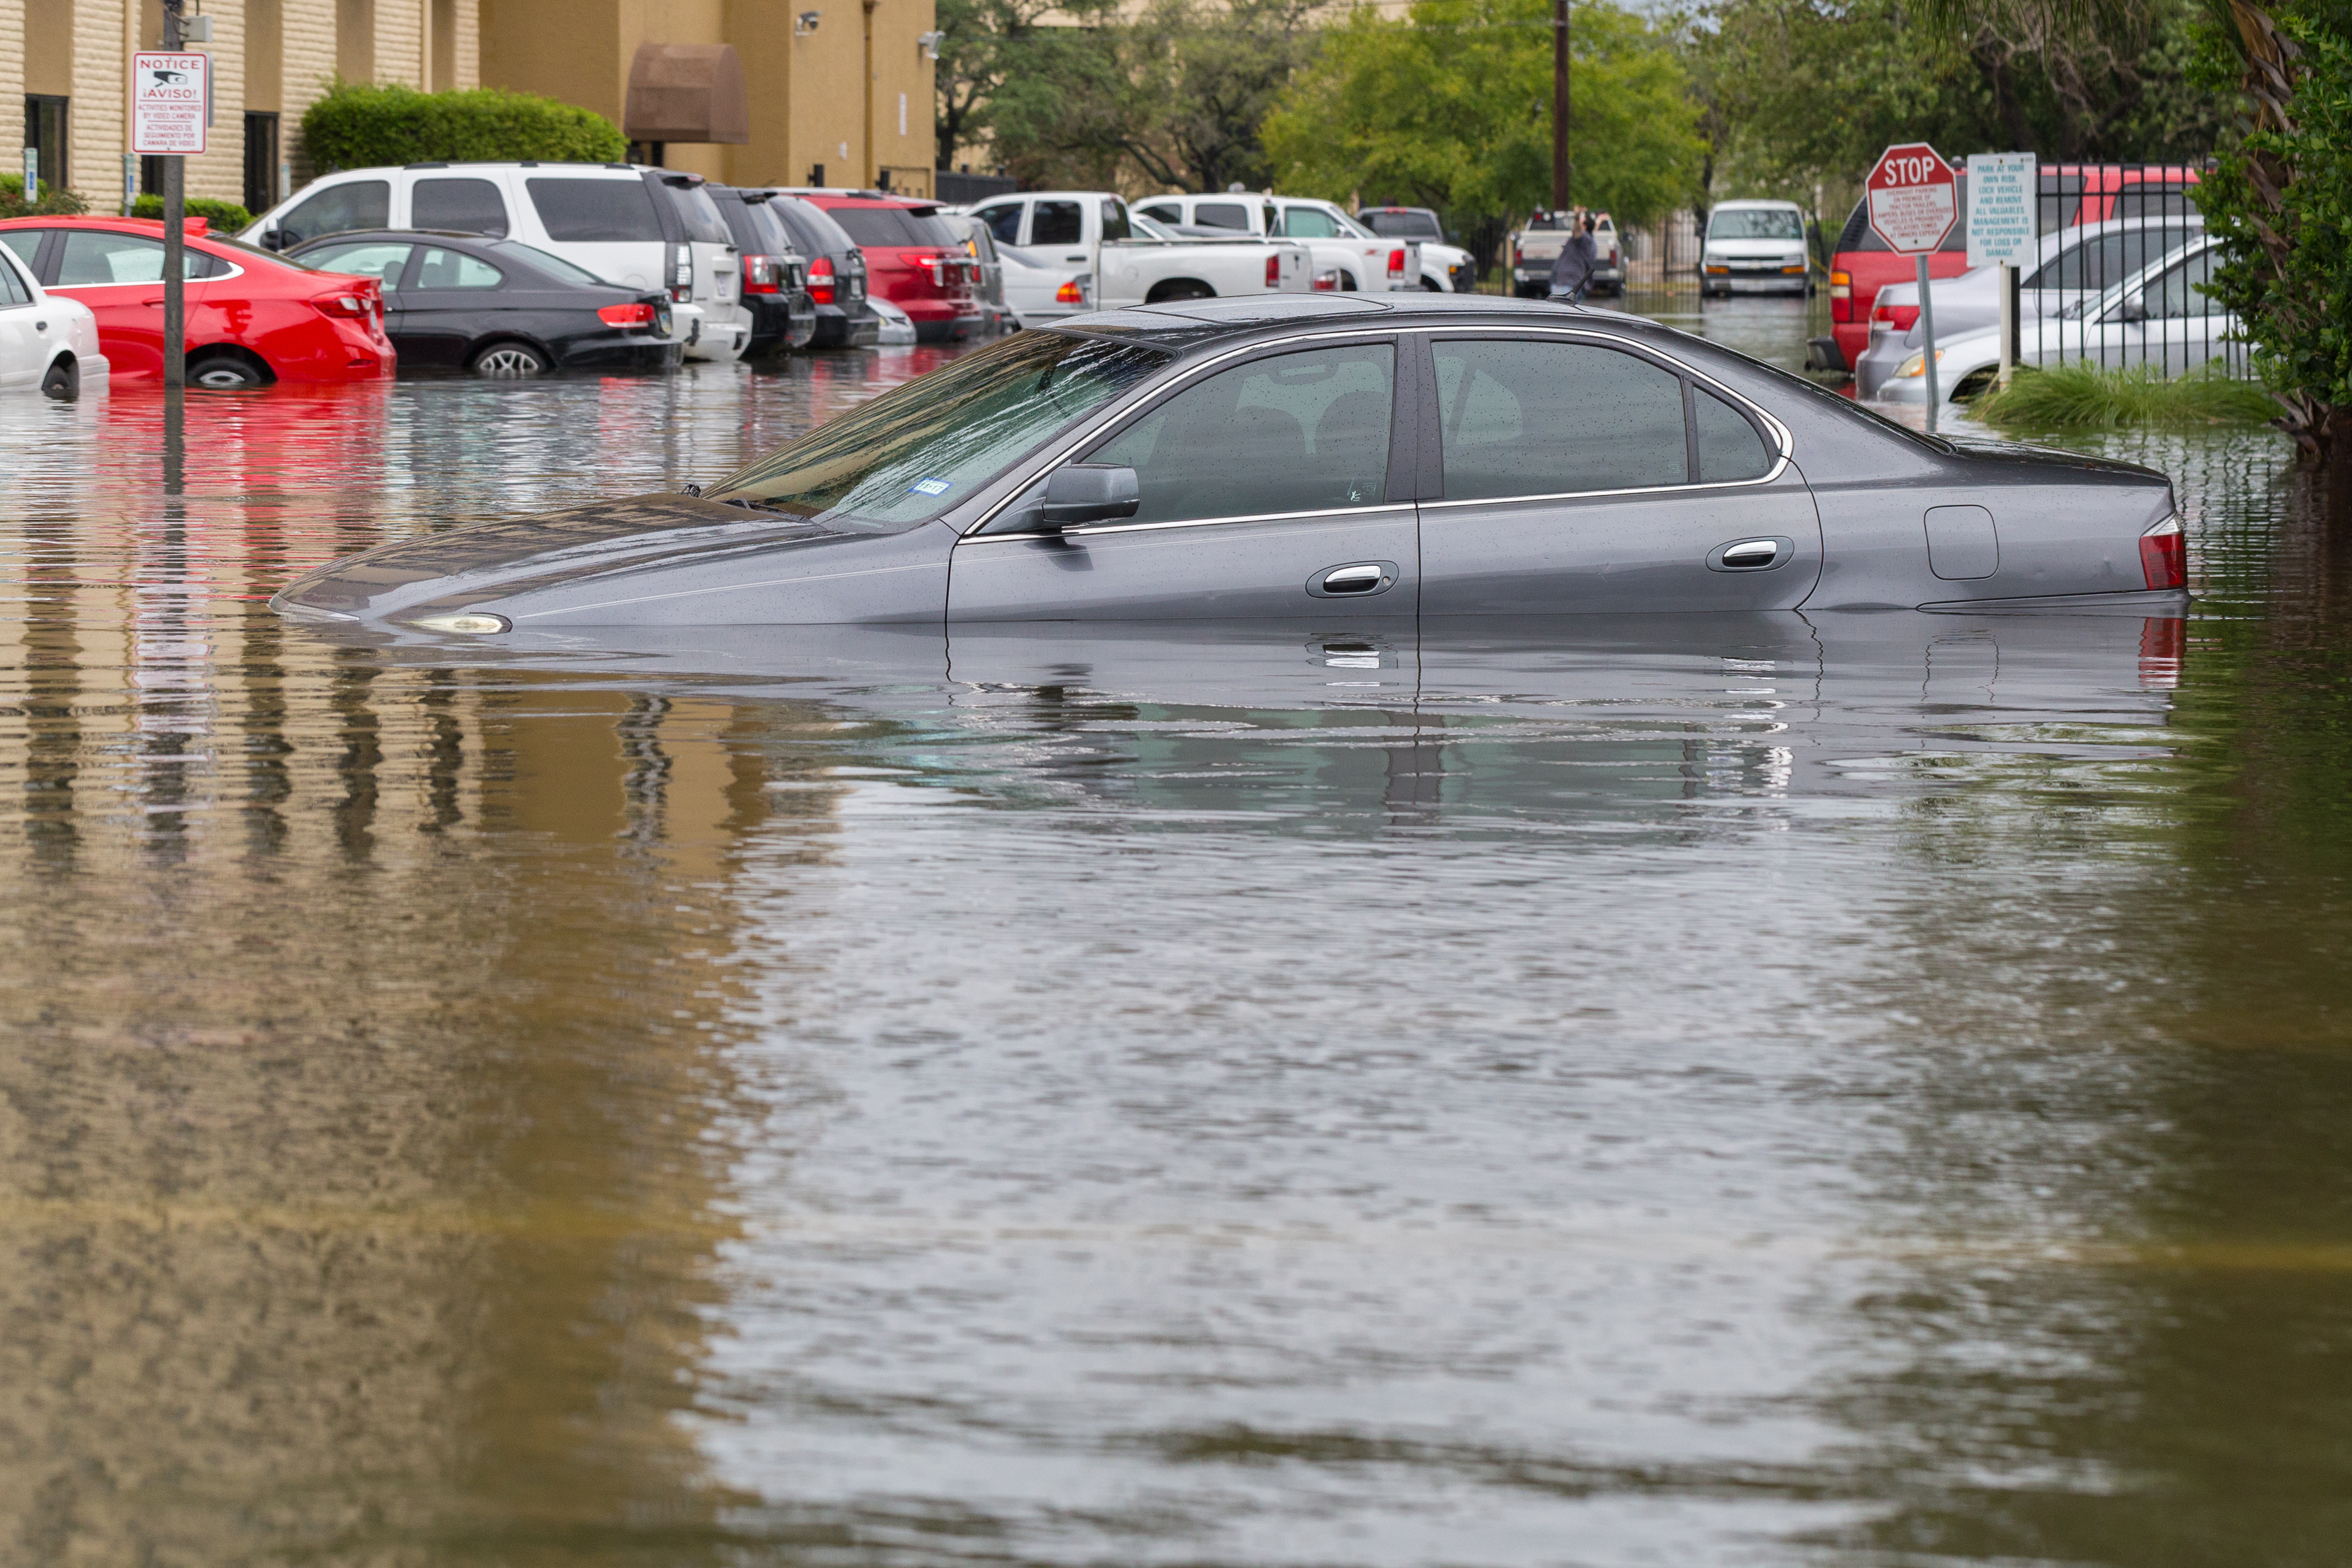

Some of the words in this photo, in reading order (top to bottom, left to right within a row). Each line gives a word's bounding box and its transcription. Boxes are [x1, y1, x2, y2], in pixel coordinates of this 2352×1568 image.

[140, 60, 201, 70] NOTICE
[143, 88, 197, 98] ¡AVISO!
[169, 104, 203, 112] MONITORED
[1884, 156, 1935, 186] STOP
[1977, 165, 1994, 173] PARK
[2008, 164, 2025, 172] YOUR
[1885, 188, 1914, 196] OVERNIGHT
[1979, 186, 1994, 194] LOCK
[1997, 184, 2022, 193] VEHICLE
[1996, 196, 2021, 204] REMOVE
[1975, 207, 1986, 215] ALL
[1973, 217, 2018, 225] MANAGEMENT
[2021, 216, 2028, 225] IS
[1986, 226, 2029, 235] RESPONSIBLE
